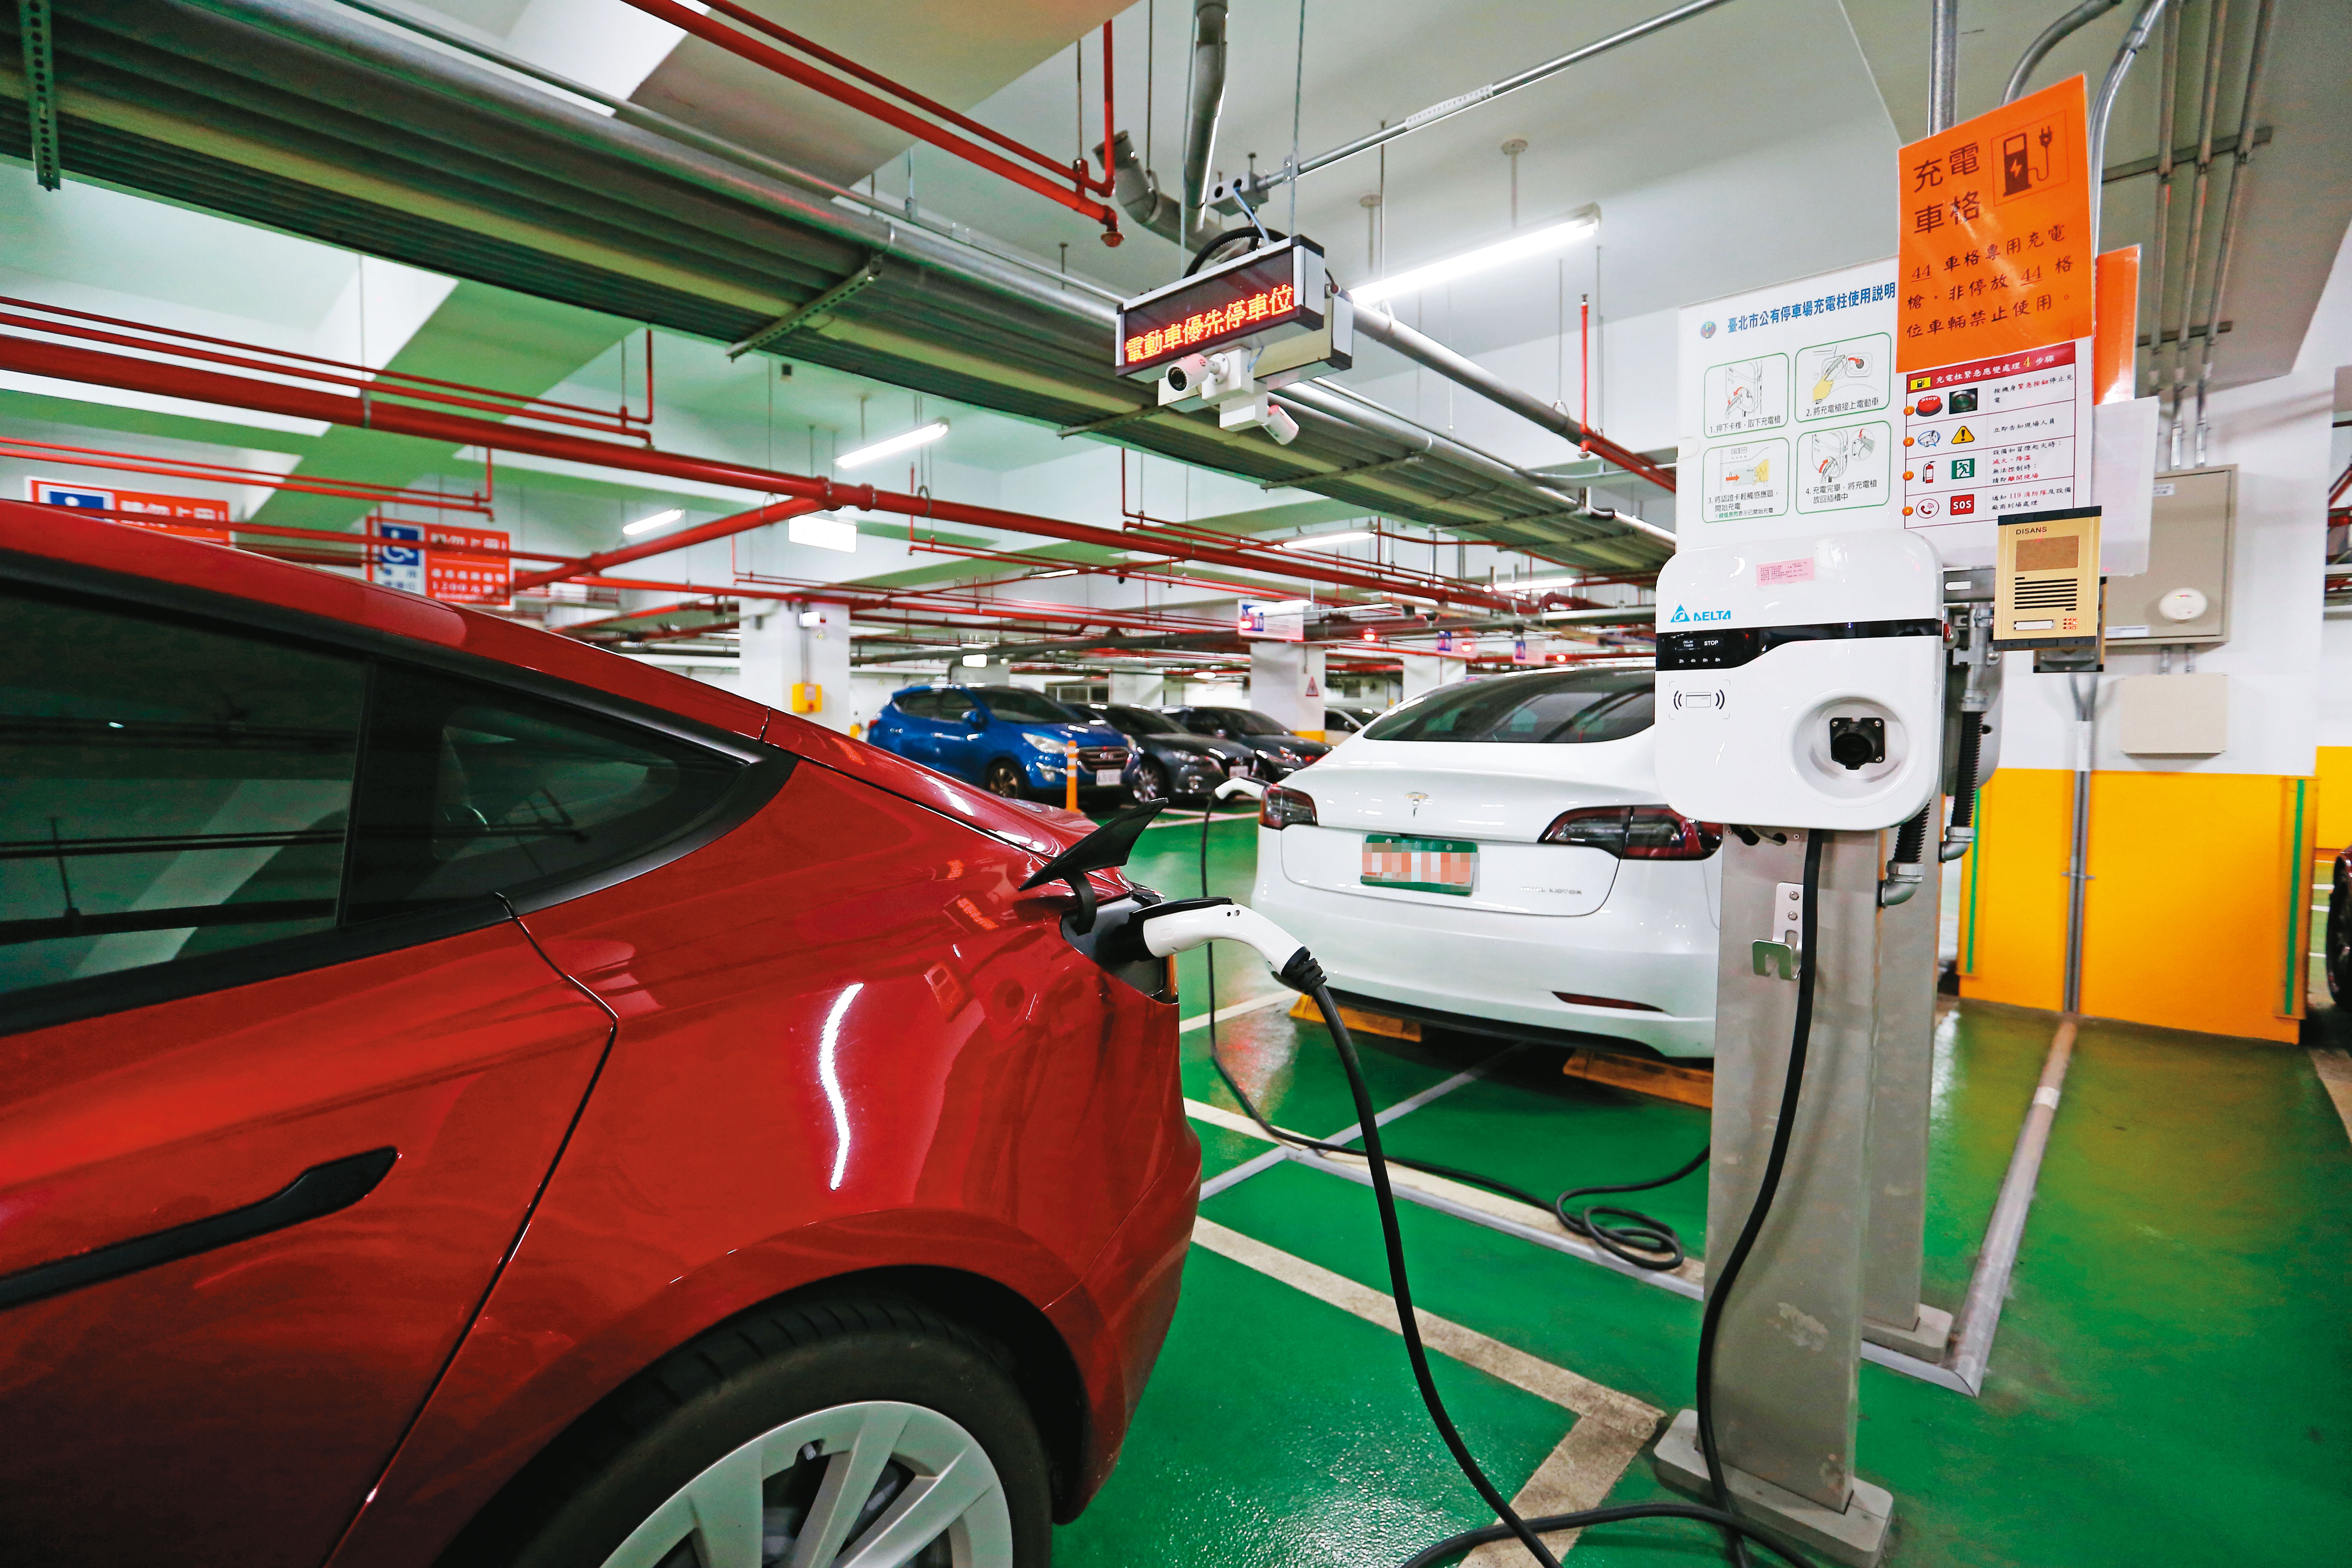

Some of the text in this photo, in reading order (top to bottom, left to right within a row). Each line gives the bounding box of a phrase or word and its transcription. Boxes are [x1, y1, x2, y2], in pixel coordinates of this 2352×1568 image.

[1913, 142, 1980, 192] 充電
[1914, 191, 1980, 233] 車格
[1911, 224, 2065, 280] 44 車格專用充電
[1907, 255, 2074, 310] 槍，非停放 44 格
[1125, 283, 1294, 362] 電動車優先停車位
[1907, 294, 2069, 339] 位車輛禁止使用。
[1936, 355, 2054, 384] 充電柱緊急應變處理 4 步驟
[1994, 418, 2054, 433] 立即告知現場人員
[1953, 500, 1971, 510] SOS
[2015, 526, 2047, 535] DISANS
[1693, 610, 1731, 621] DELTA
